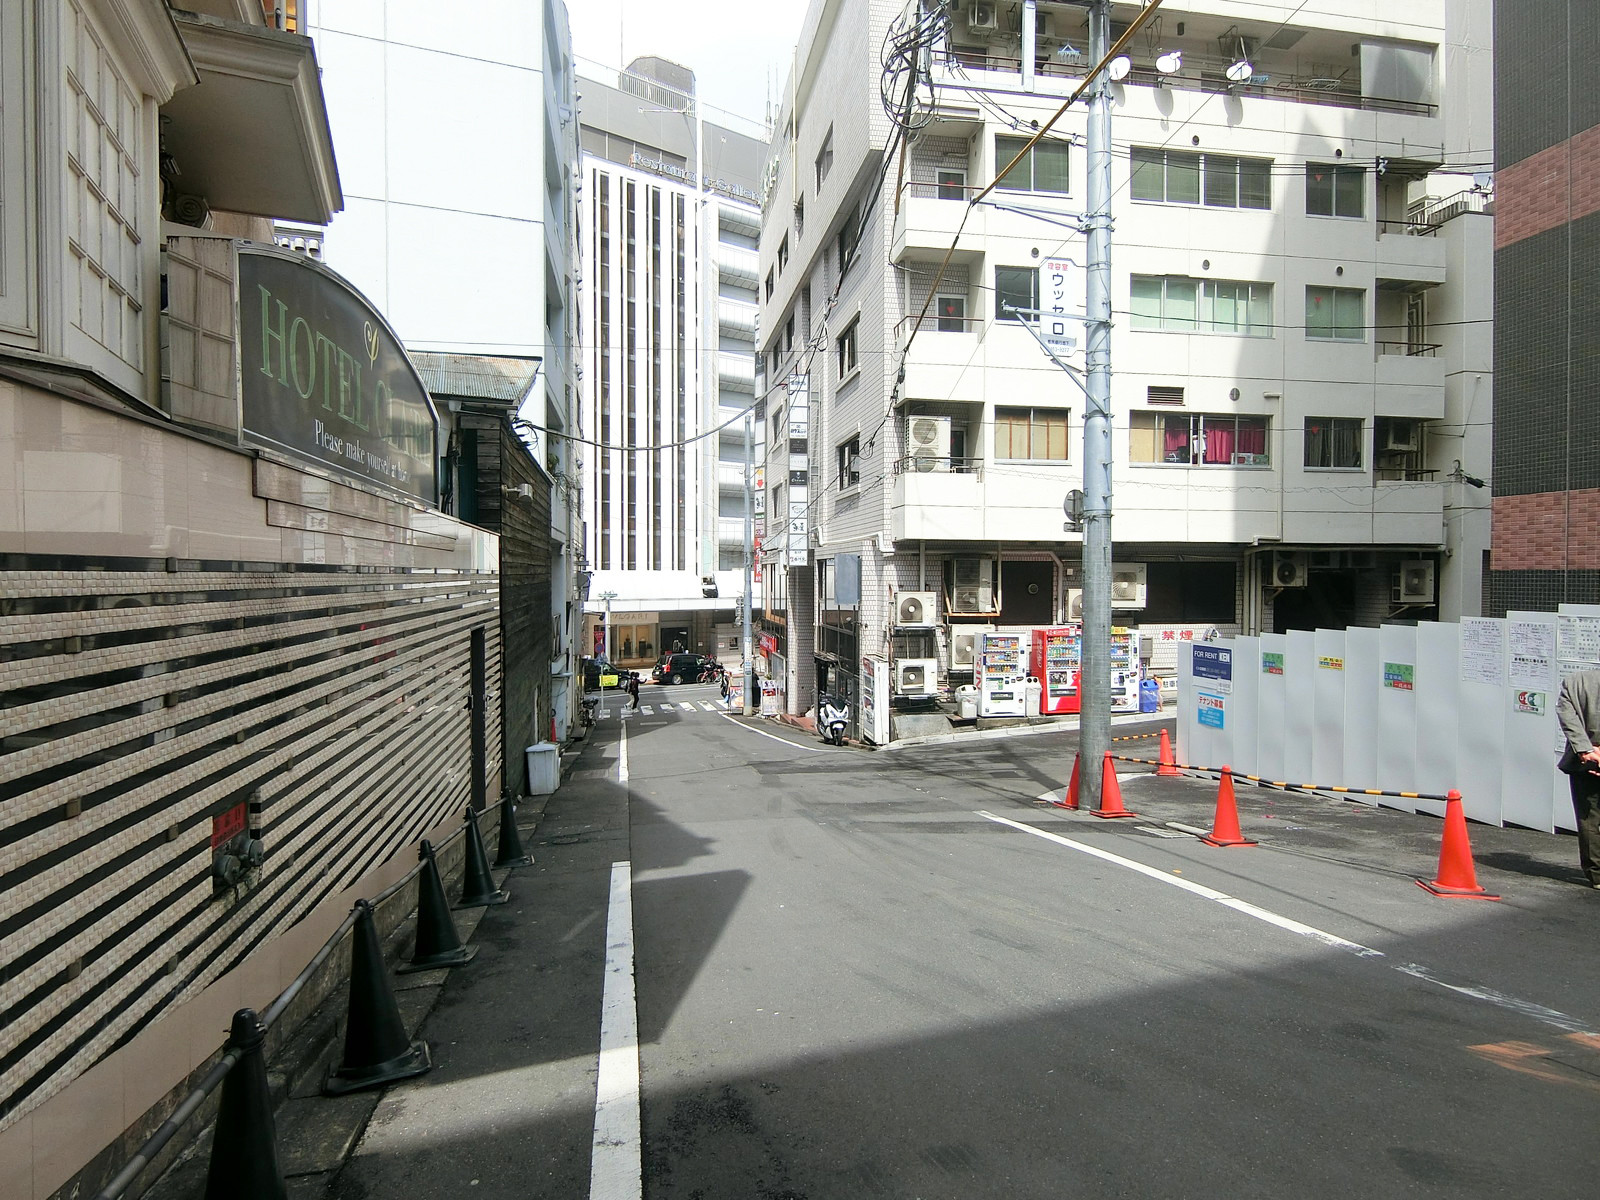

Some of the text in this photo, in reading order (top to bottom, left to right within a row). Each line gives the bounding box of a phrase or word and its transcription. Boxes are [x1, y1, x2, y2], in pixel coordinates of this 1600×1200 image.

[634, 152, 709, 186] Restaurat
[258, 284, 369, 432] HOTEL
[315, 419, 343, 455] Please
[346, 440, 365, 464] make
[1162, 630, 1193, 640] 禁煙
[1194, 650, 1204, 658] FOR
[1204, 651, 1217, 660] RENT
